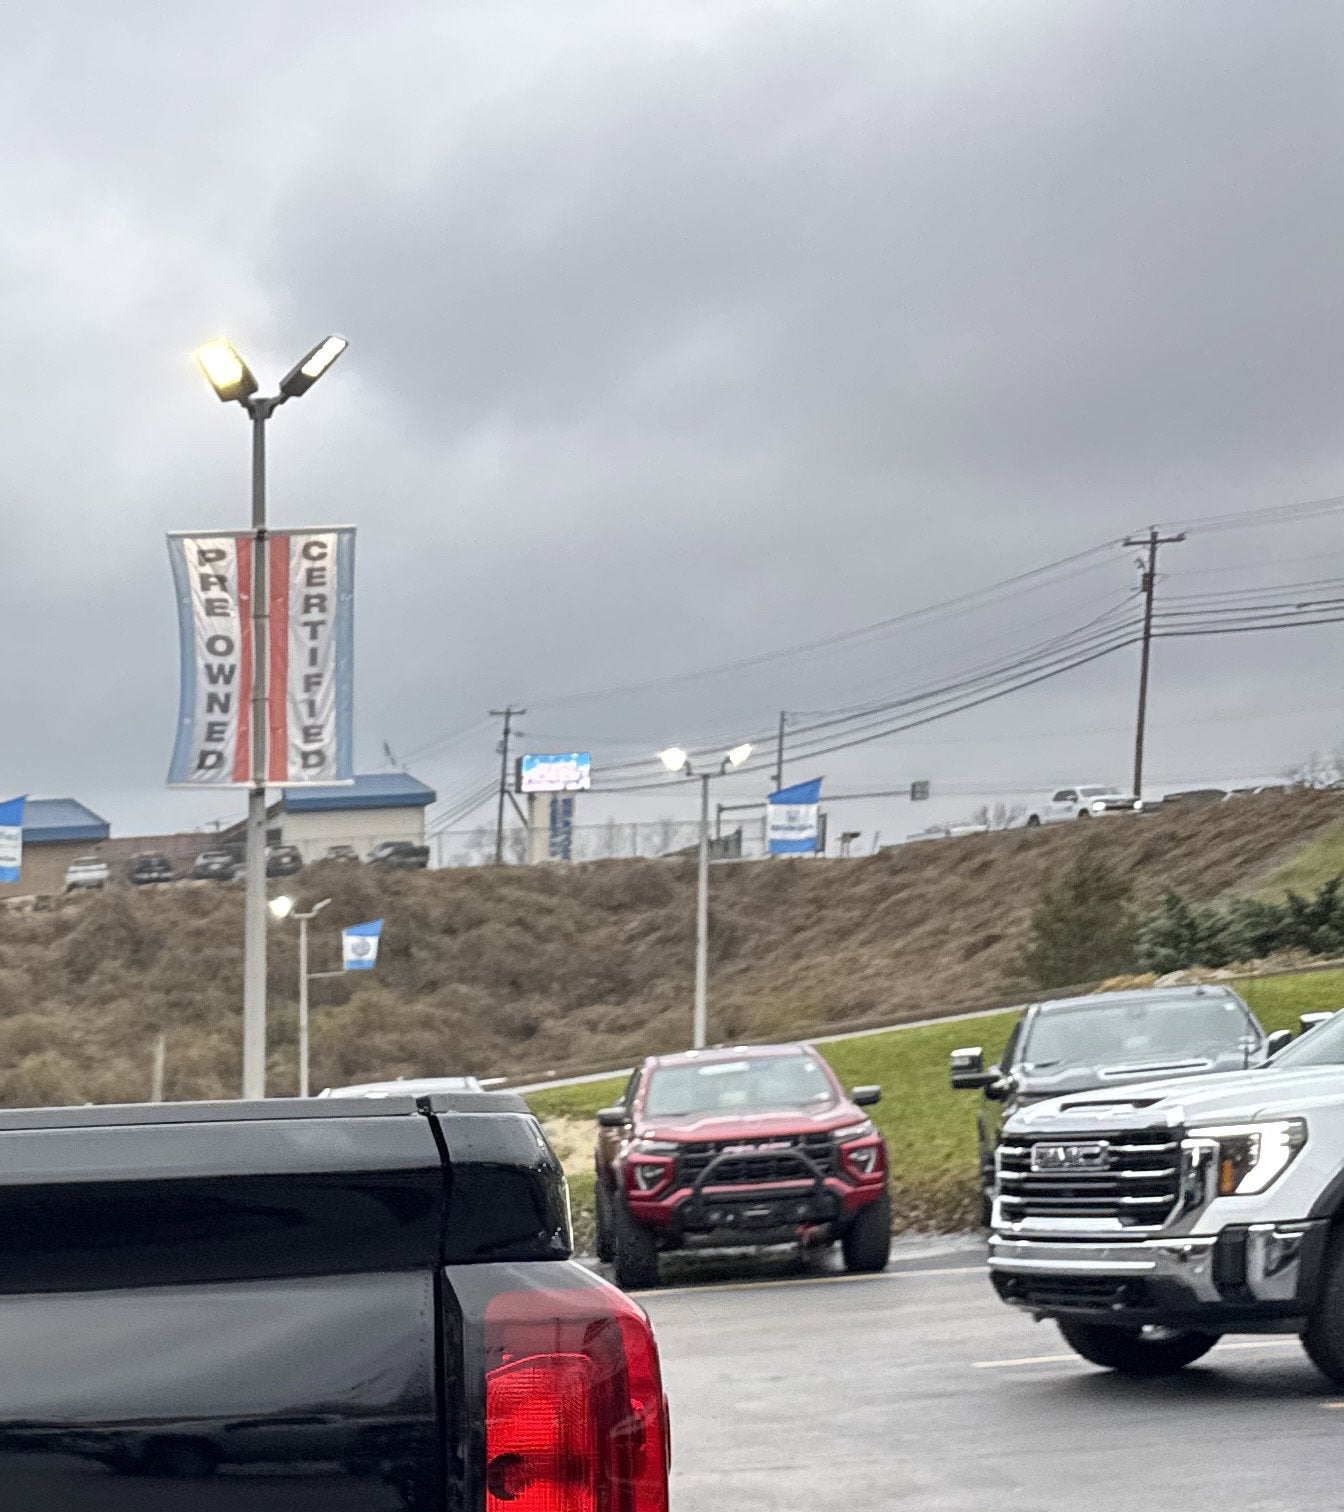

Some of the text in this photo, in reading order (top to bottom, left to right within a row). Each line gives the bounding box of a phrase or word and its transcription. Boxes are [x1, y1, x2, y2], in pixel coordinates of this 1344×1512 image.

[197, 548, 236, 771] PRE OWNED
[301, 540, 328, 770] CERTIFIED
